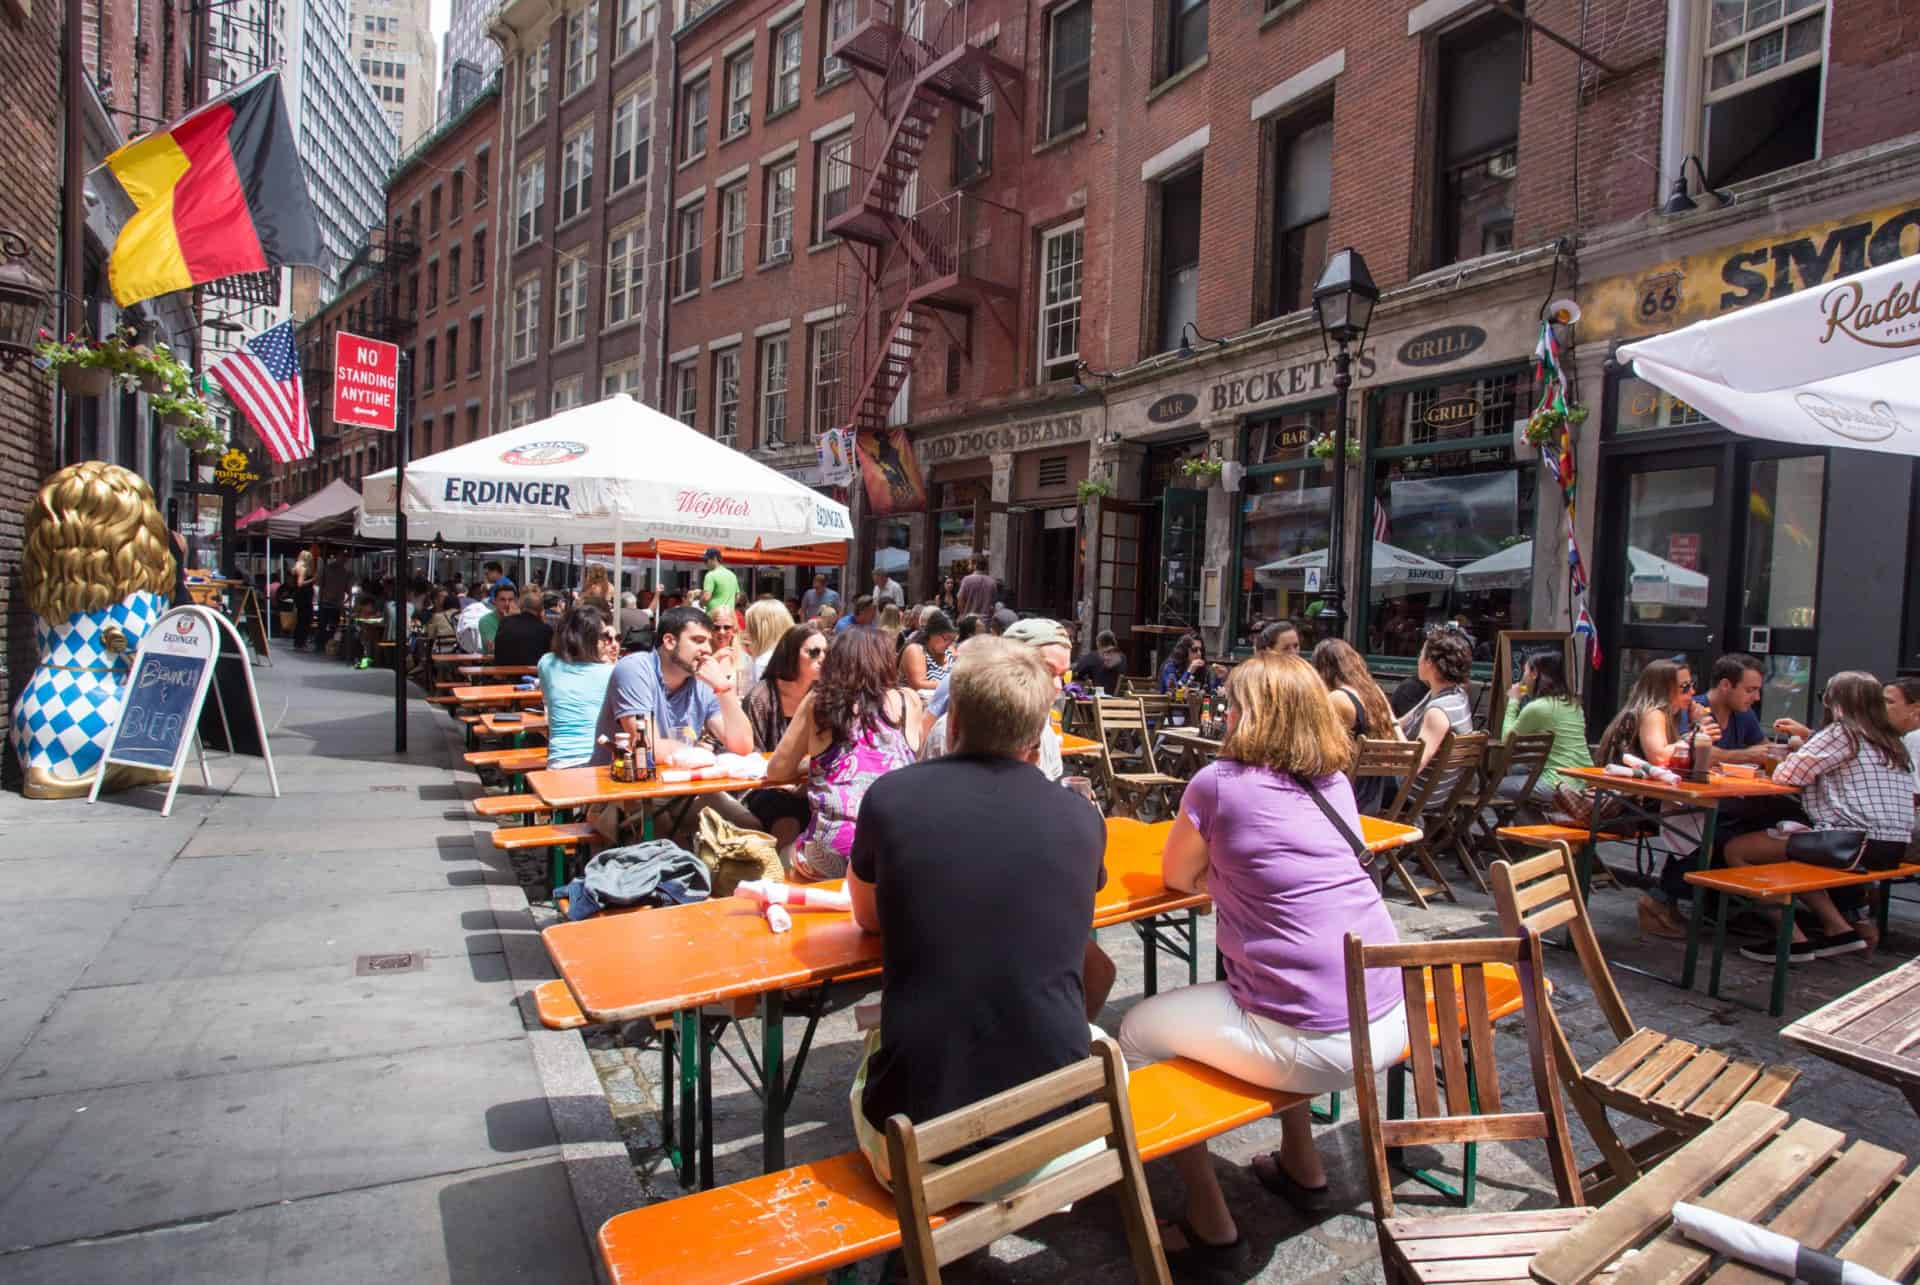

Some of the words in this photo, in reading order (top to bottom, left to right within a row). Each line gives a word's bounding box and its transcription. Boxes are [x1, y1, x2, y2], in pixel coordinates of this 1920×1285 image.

[1641, 287, 1677, 316] 66
[1886, 319, 1920, 337] PILS
[357, 346, 378, 367] NO
[1408, 332, 1472, 360] GRILL
[338, 366, 395, 390] STANDING
[341, 386, 392, 408] ANYTIME
[1160, 400, 1184, 417] BAR
[1428, 402, 1480, 422] GRILL
[922, 438, 956, 459] MAD
[959, 431, 998, 454] DOG
[1001, 427, 1015, 449] &
[1016, 414, 1083, 445] BEANS
[1282, 430, 1307, 446] BAR
[444, 477, 571, 509] ERDINGER
[676, 488, 751, 520] Weißbier
[1307, 571, 1318, 585] A
[119, 705, 183, 742] BIER
